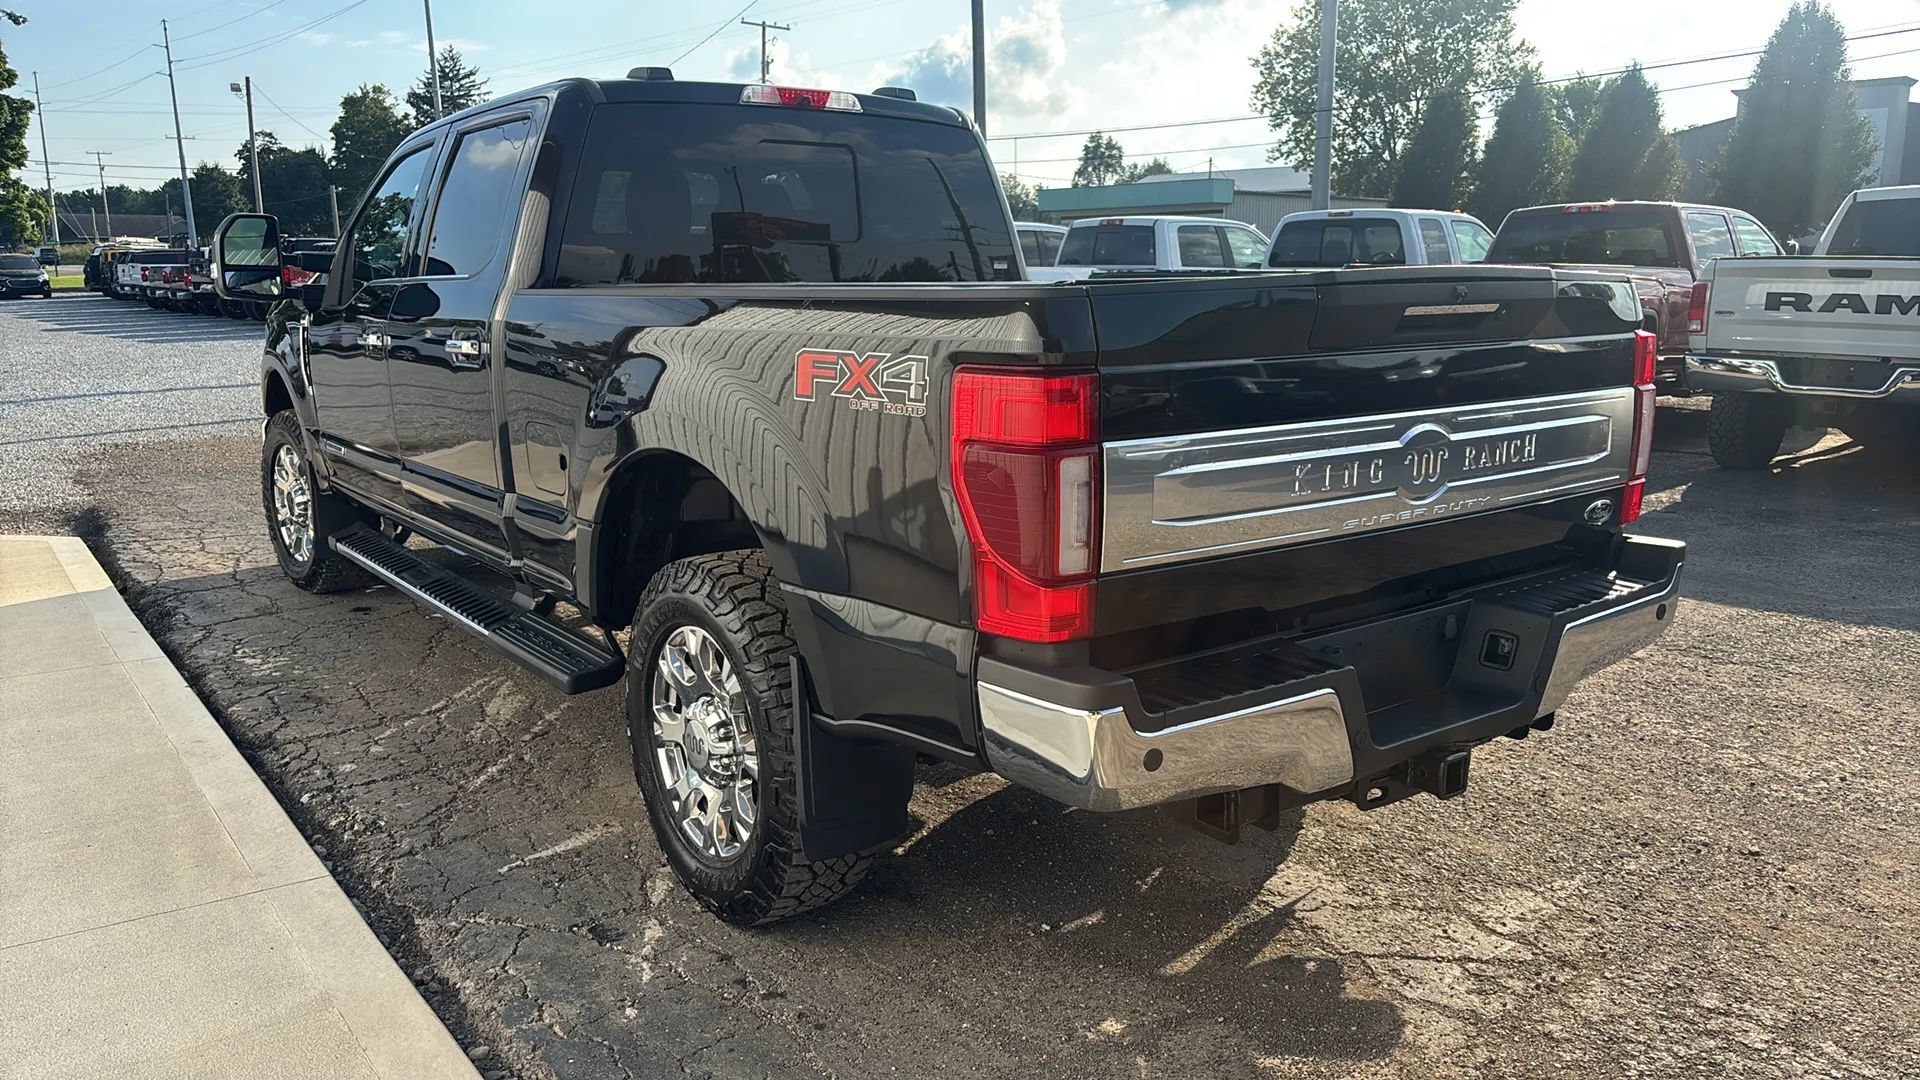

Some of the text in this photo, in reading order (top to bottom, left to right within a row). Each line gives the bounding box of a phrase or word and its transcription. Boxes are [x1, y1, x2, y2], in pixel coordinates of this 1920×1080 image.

[1764, 292, 1920, 316] RAM
[794, 348, 929, 406] FX4
[849, 399, 927, 417] OFF ROAD
[1290, 433, 1537, 497] KING RANCH
[1342, 496, 1491, 530] SUPER DUTY
